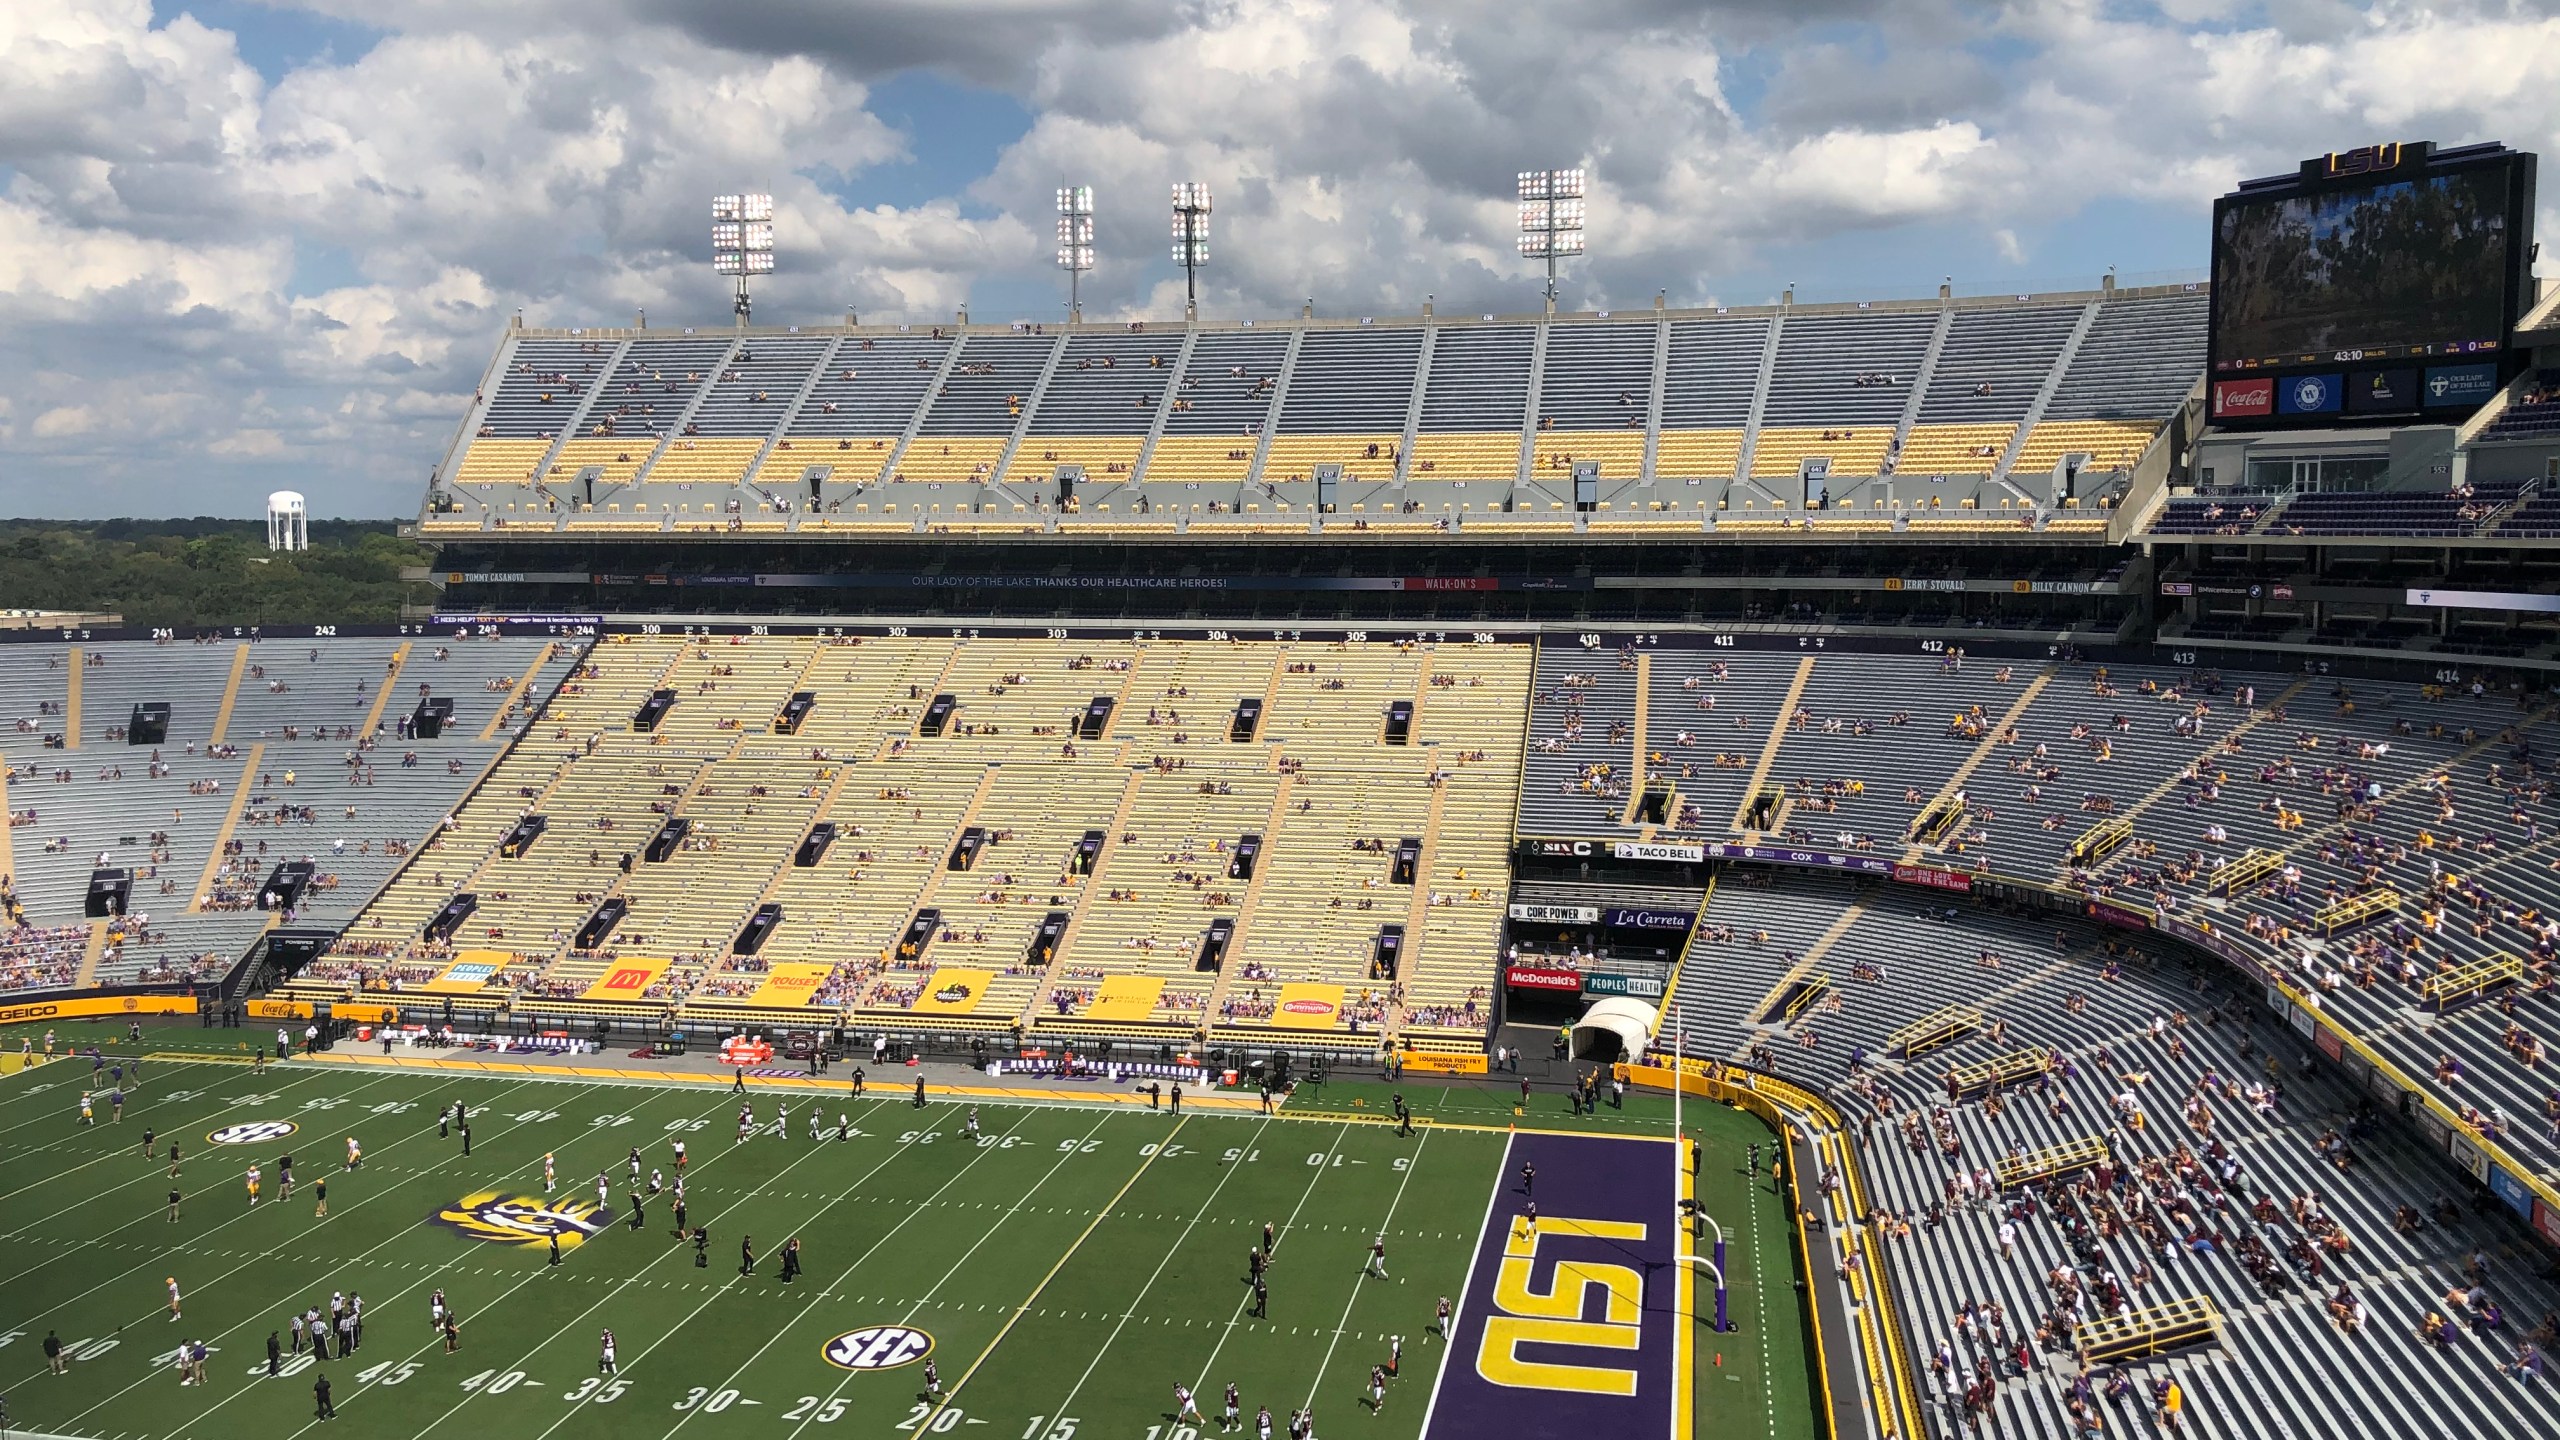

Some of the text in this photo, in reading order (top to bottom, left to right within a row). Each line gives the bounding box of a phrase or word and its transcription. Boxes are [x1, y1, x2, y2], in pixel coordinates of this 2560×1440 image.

[2322, 141, 2401, 180] LSU
[2426, 345, 2432, 355] 1
[2468, 341, 2476, 351] 0
[2333, 349, 2363, 361] 43:10
[2235, 359, 2243, 368] 0
[465, 573, 525, 582] TOMMY CASANOVA
[912, 577, 1227, 588] OUR LADY OF THE LAKE THANKS OUR HEALTHCARE HEROES!
[1424, 578, 1477, 589] WALK-ON'S
[1888, 580, 1966, 590] 21 JERRY STOVALL
[2016, 582, 2090, 593] 20 BILLY CANNON
[152, 628, 174, 639] 241
[315, 625, 336, 636] 242
[576, 625, 595, 635] 244
[641, 625, 661, 634] 300
[751, 625, 769, 635] 301
[888, 627, 907, 637] 302
[1047, 629, 1068, 638] 303
[1207, 630, 1228, 641] 304
[1346, 631, 1367, 641] 305
[1473, 632, 1495, 643] 306
[1579, 634, 1601, 645] 410
[1714, 635, 1734, 646] 411
[1921, 641, 1944, 652] 412
[2173, 652, 2195, 664] 413
[2436, 669, 2460, 683] 414
[1543, 842, 1592, 856] SIX C
[1637, 847, 1697, 859] TACO BELL
[1791, 852, 1813, 862] COX
[1917, 869, 1951, 880] ONE LOVE
[1917, 876, 1969, 890] FOR THE GAME
[1526, 906, 1579, 920] CORE POWER
[1615, 909, 1686, 927] La Carreta
[454, 963, 495, 973] PEOPLES
[770, 976, 819, 987] ROUSES
[1511, 972, 1577, 986] McDonald's
[1591, 978, 1660, 993] PEOPLES HEALTH
[0, 1005, 58, 1020] GEICO
[1284, 1003, 1332, 1014] Community
[1418, 1056, 1453, 1064] LOUISIANA
[1433, 1062, 1467, 1070] PRODUCTS
[229, 1093, 281, 1106] 20
[298, 1097, 350, 1110] 25
[367, 1101, 419, 1114] 30
[515, 1110, 560, 1122] 40
[588, 1114, 634, 1127] 45
[663, 1118, 711, 1132] 50
[213, 1121, 292, 1142] SEC
[896, 1131, 942, 1145] 35
[976, 1134, 1023, 1149] 30
[1056, 1138, 1103, 1153] 25
[1139, 1143, 1186, 1158] 20
[1223, 1148, 1260, 1162] 15
[1306, 1152, 1345, 1167] 10
[1391, 1157, 1410, 1171] 5
[2003, 1229, 2011, 1239] 9
[1475, 1214, 1647, 1397] LSU
[830, 1328, 928, 1367] SEC
[355, 1361, 425, 1386] 45
[460, 1370, 529, 1394] 40
[565, 1378, 634, 1403] 35
[673, 1387, 741, 1414] 30
[782, 1396, 853, 1423] 25
[896, 1406, 965, 1433] 20
[1022, 1414, 1081, 1440] 15
[1146, 1425, 1199, 1440] 10
